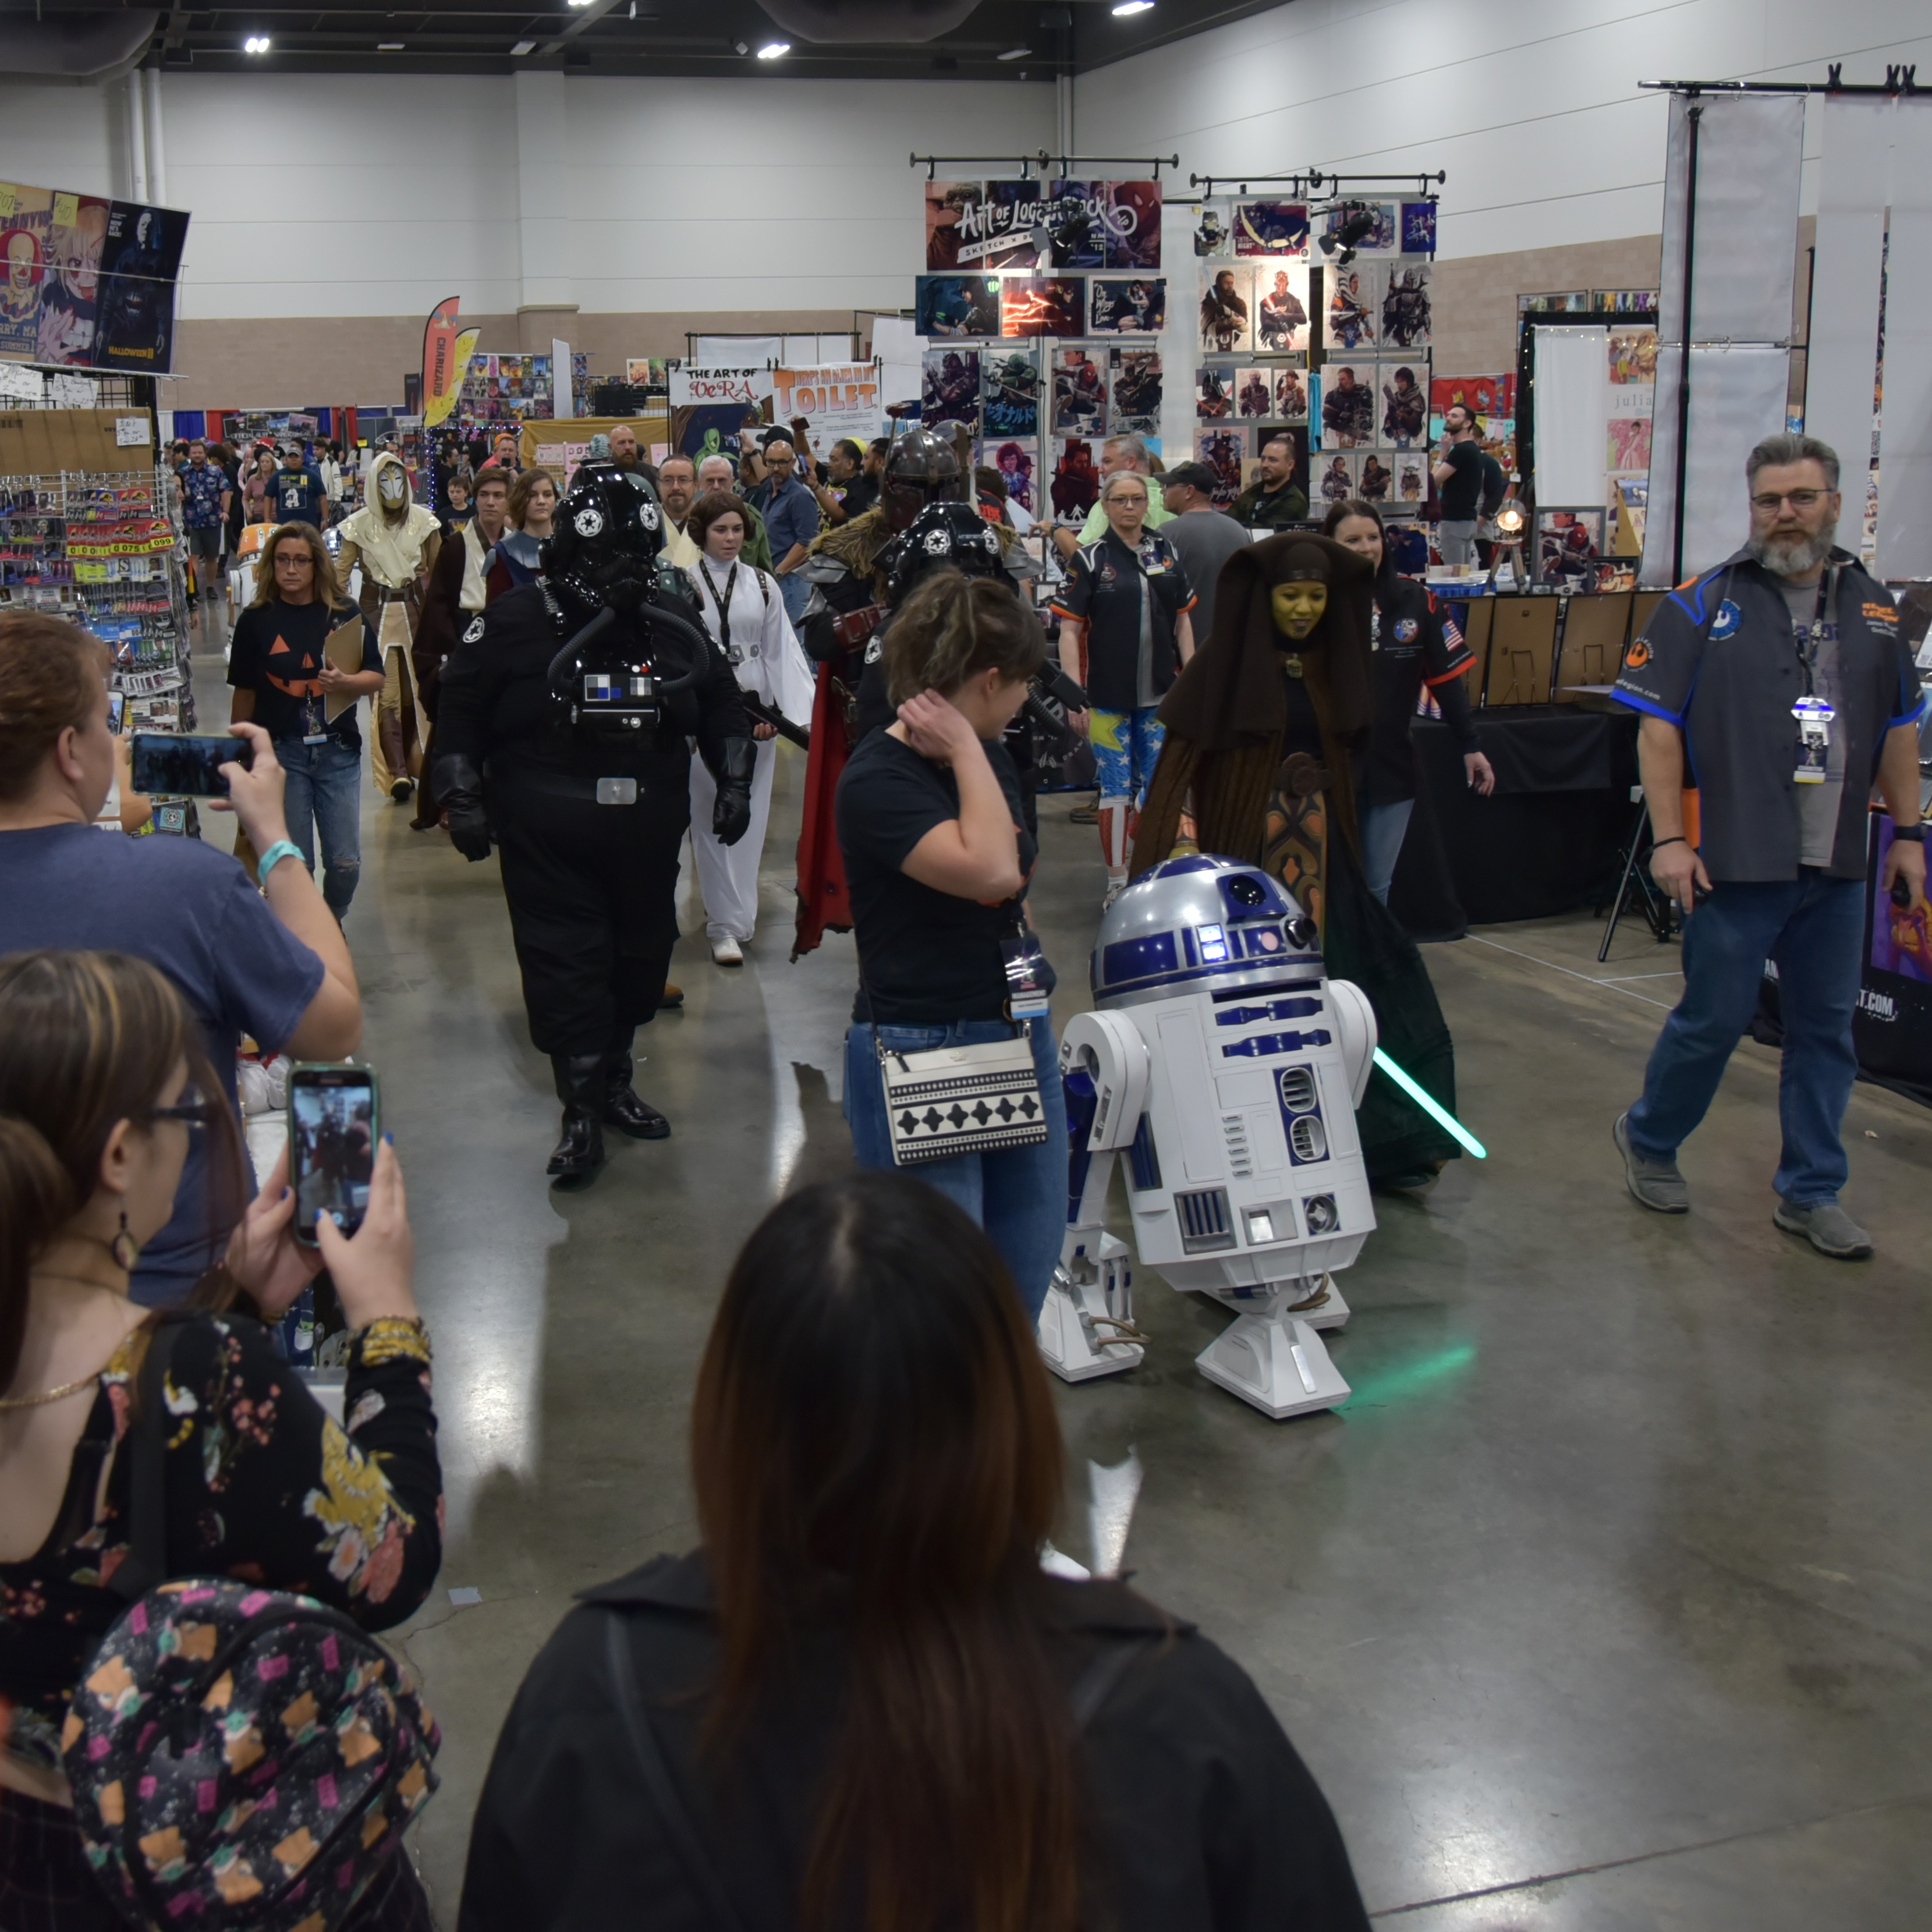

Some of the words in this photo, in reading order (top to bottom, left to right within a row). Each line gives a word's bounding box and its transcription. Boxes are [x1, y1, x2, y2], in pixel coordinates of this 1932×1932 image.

[55, 197, 72, 221] $40
[966, 240, 1005, 257] SKETCH
[1, 341, 30, 351] SUMMER
[108, 346, 147, 358] HALLOWEEN
[147, 348, 154, 359] II
[433, 337, 446, 397] CHARIZARD
[686, 370, 710, 379] THE
[713, 368, 739, 378] ART
[742, 368, 758, 377] OF
[821, 369, 832, 385] AN
[833, 368, 853, 384] ALIEN
[853, 367, 863, 382] IN
[863, 366, 875, 381] MY
[1615, 394, 1652, 409] julia
[986, 402, 1036, 424] レオナルド
[154, 538, 171, 546] 099
[1062, 739, 1084, 761] DRAW
[1856, 988, 1894, 1016] T.COM
